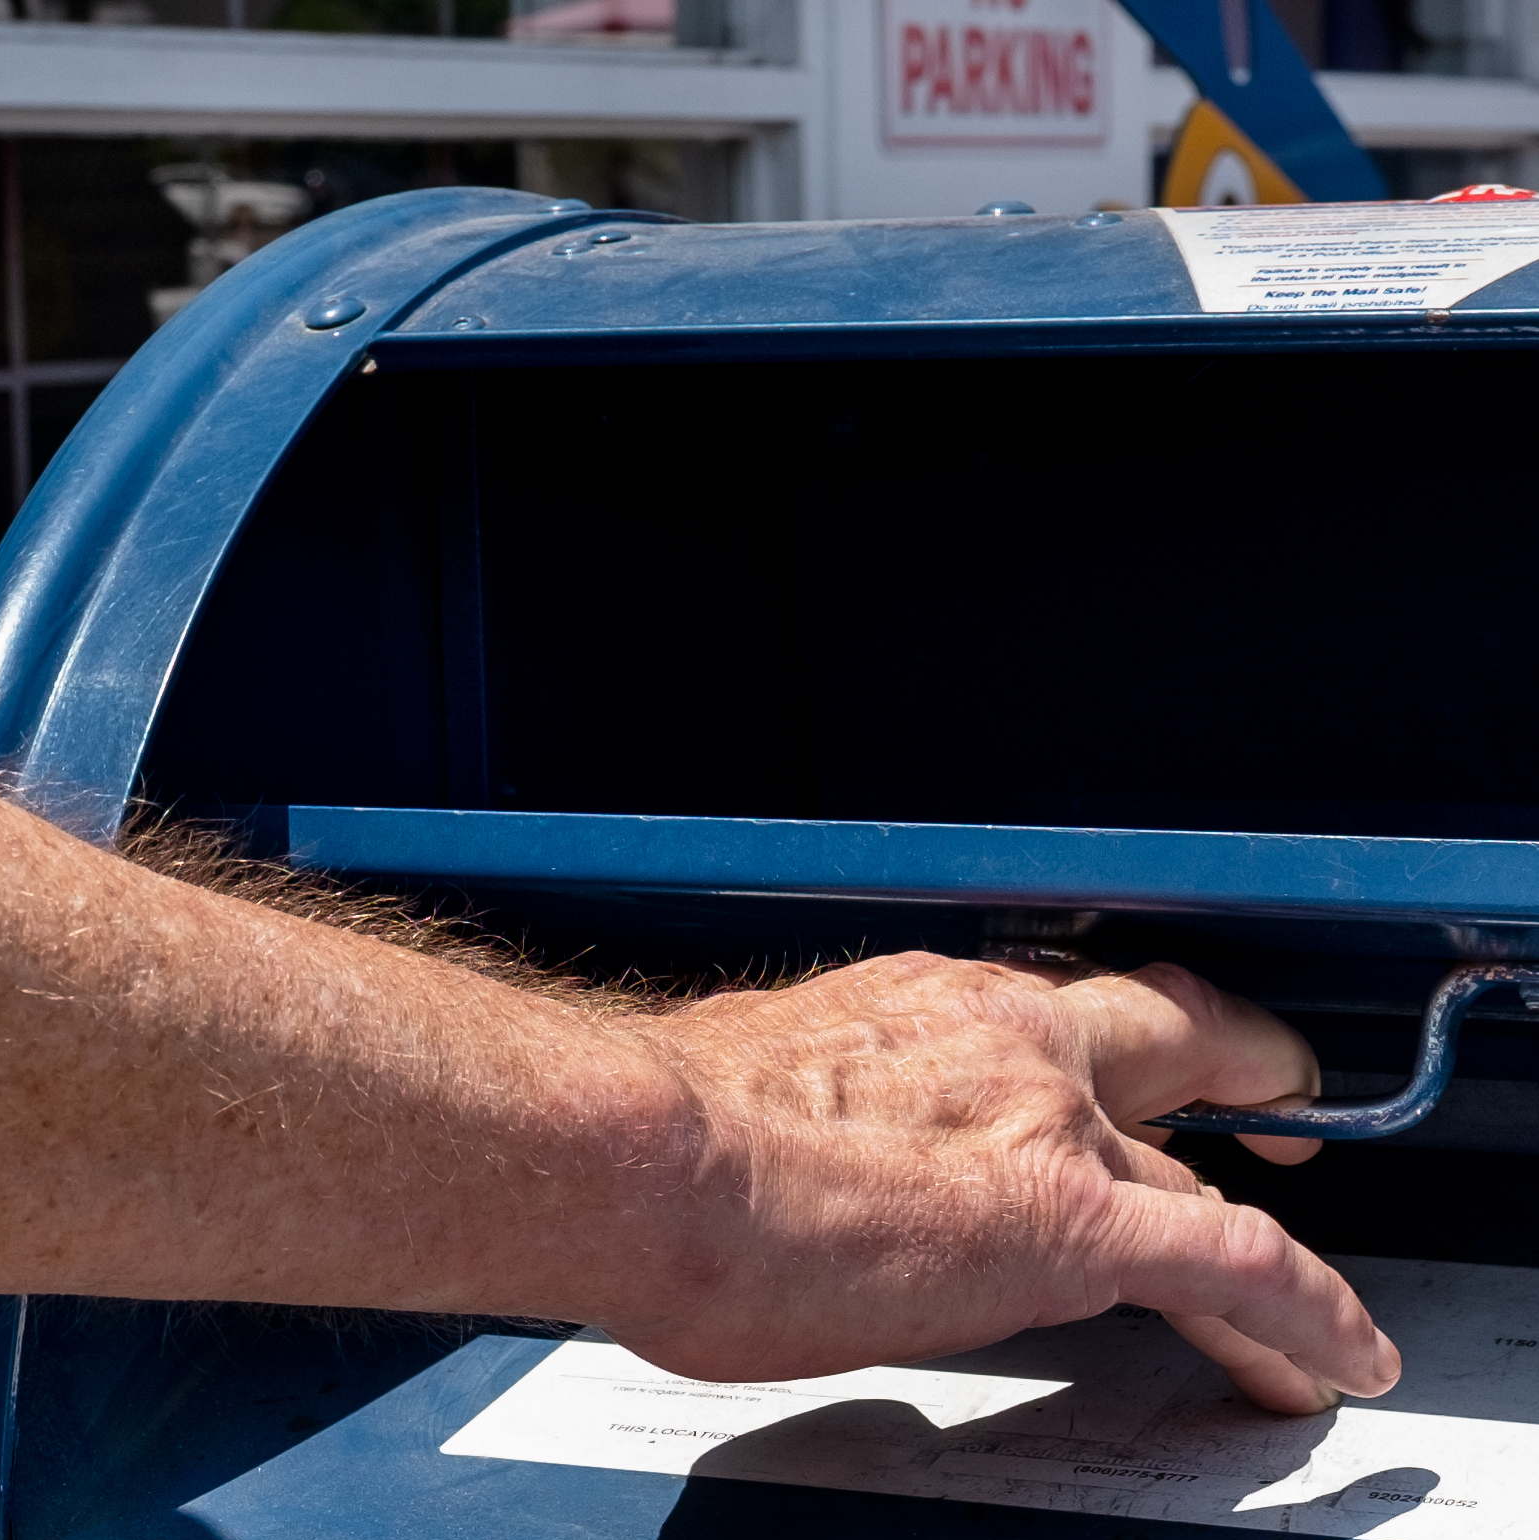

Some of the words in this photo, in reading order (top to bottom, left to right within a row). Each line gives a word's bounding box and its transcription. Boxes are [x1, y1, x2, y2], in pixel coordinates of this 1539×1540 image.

[901, 23, 1095, 114] PARKING
[1343, 287, 1380, 295] Mail
[1383, 285, 1428, 295] Safe!
[1341, 299, 1424, 310] prohibited
[1494, 1337, 1538, 1348] 1150
[609, 1423, 647, 1432] THIS
[649, 1427, 737, 1441] LOCATION
[1054, 1449, 1188, 1469] information
